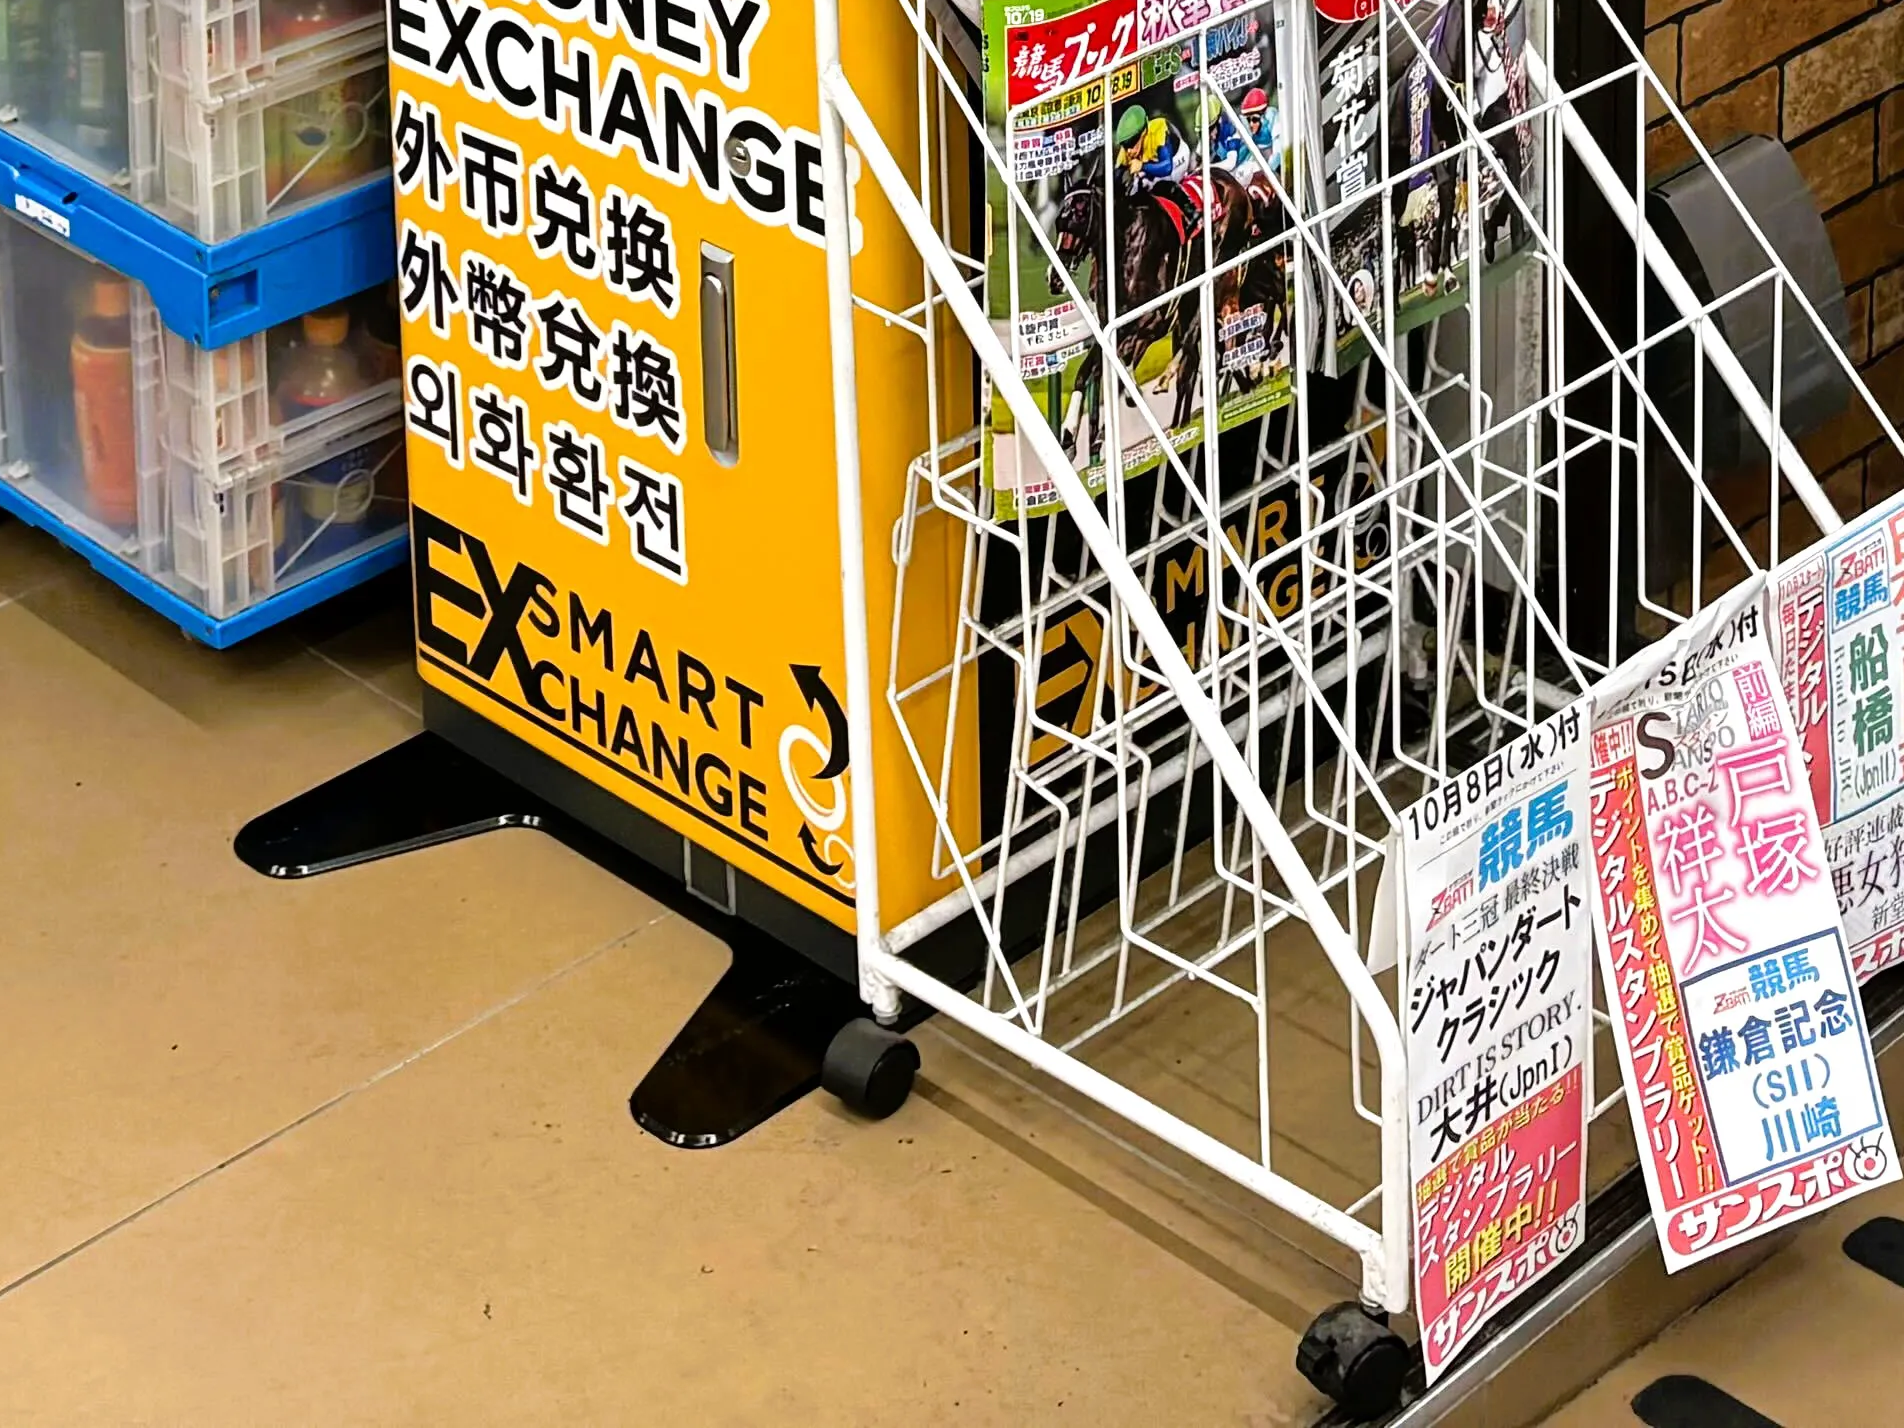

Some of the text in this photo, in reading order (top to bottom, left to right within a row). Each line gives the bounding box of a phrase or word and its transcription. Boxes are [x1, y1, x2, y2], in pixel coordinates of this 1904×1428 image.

[1004, 8, 1045, 25] 10/19
[1330, 44, 1370, 204] 菊花賞
[396, 102, 675, 307] 外币兑换
[401, 231, 683, 446] 外幣兌換
[409, 364, 684, 578] 외화환전
[529, 572, 765, 751] SMART
[1835, 570, 1889, 623] 競馬
[536, 666, 769, 843] CHANGE
[1733, 661, 1783, 740] 前編
[1849, 622, 1893, 758] 船橋
[1408, 706, 1580, 841] 10月8日(水)付
[1479, 780, 1574, 893] 競馬
[1718, 737, 1819, 896] 戸塚
[1657, 804, 1749, 976] 祥太
[1410, 884, 1582, 1033] ジャパンダート
[1441, 949, 1561, 1063] クラシック
[1591, 771, 1686, 1200] デジタルスタンプラリー
[1748, 948, 1820, 1002] 競馬
[1418, 991, 1582, 1126] DIRT IS STORY.
[1699, 989, 1854, 1081] 鎌倉記念
[1419, 1143, 1515, 1239] デジタル
[1762, 1095, 1841, 1161] 川崎
[1420, 1140, 1578, 1277] スタンプラリー
[1445, 1180, 1558, 1299] 開催中!!
[1679, 1150, 1845, 1252] サンスポ
[1433, 1230, 1549, 1358] サンスポ
